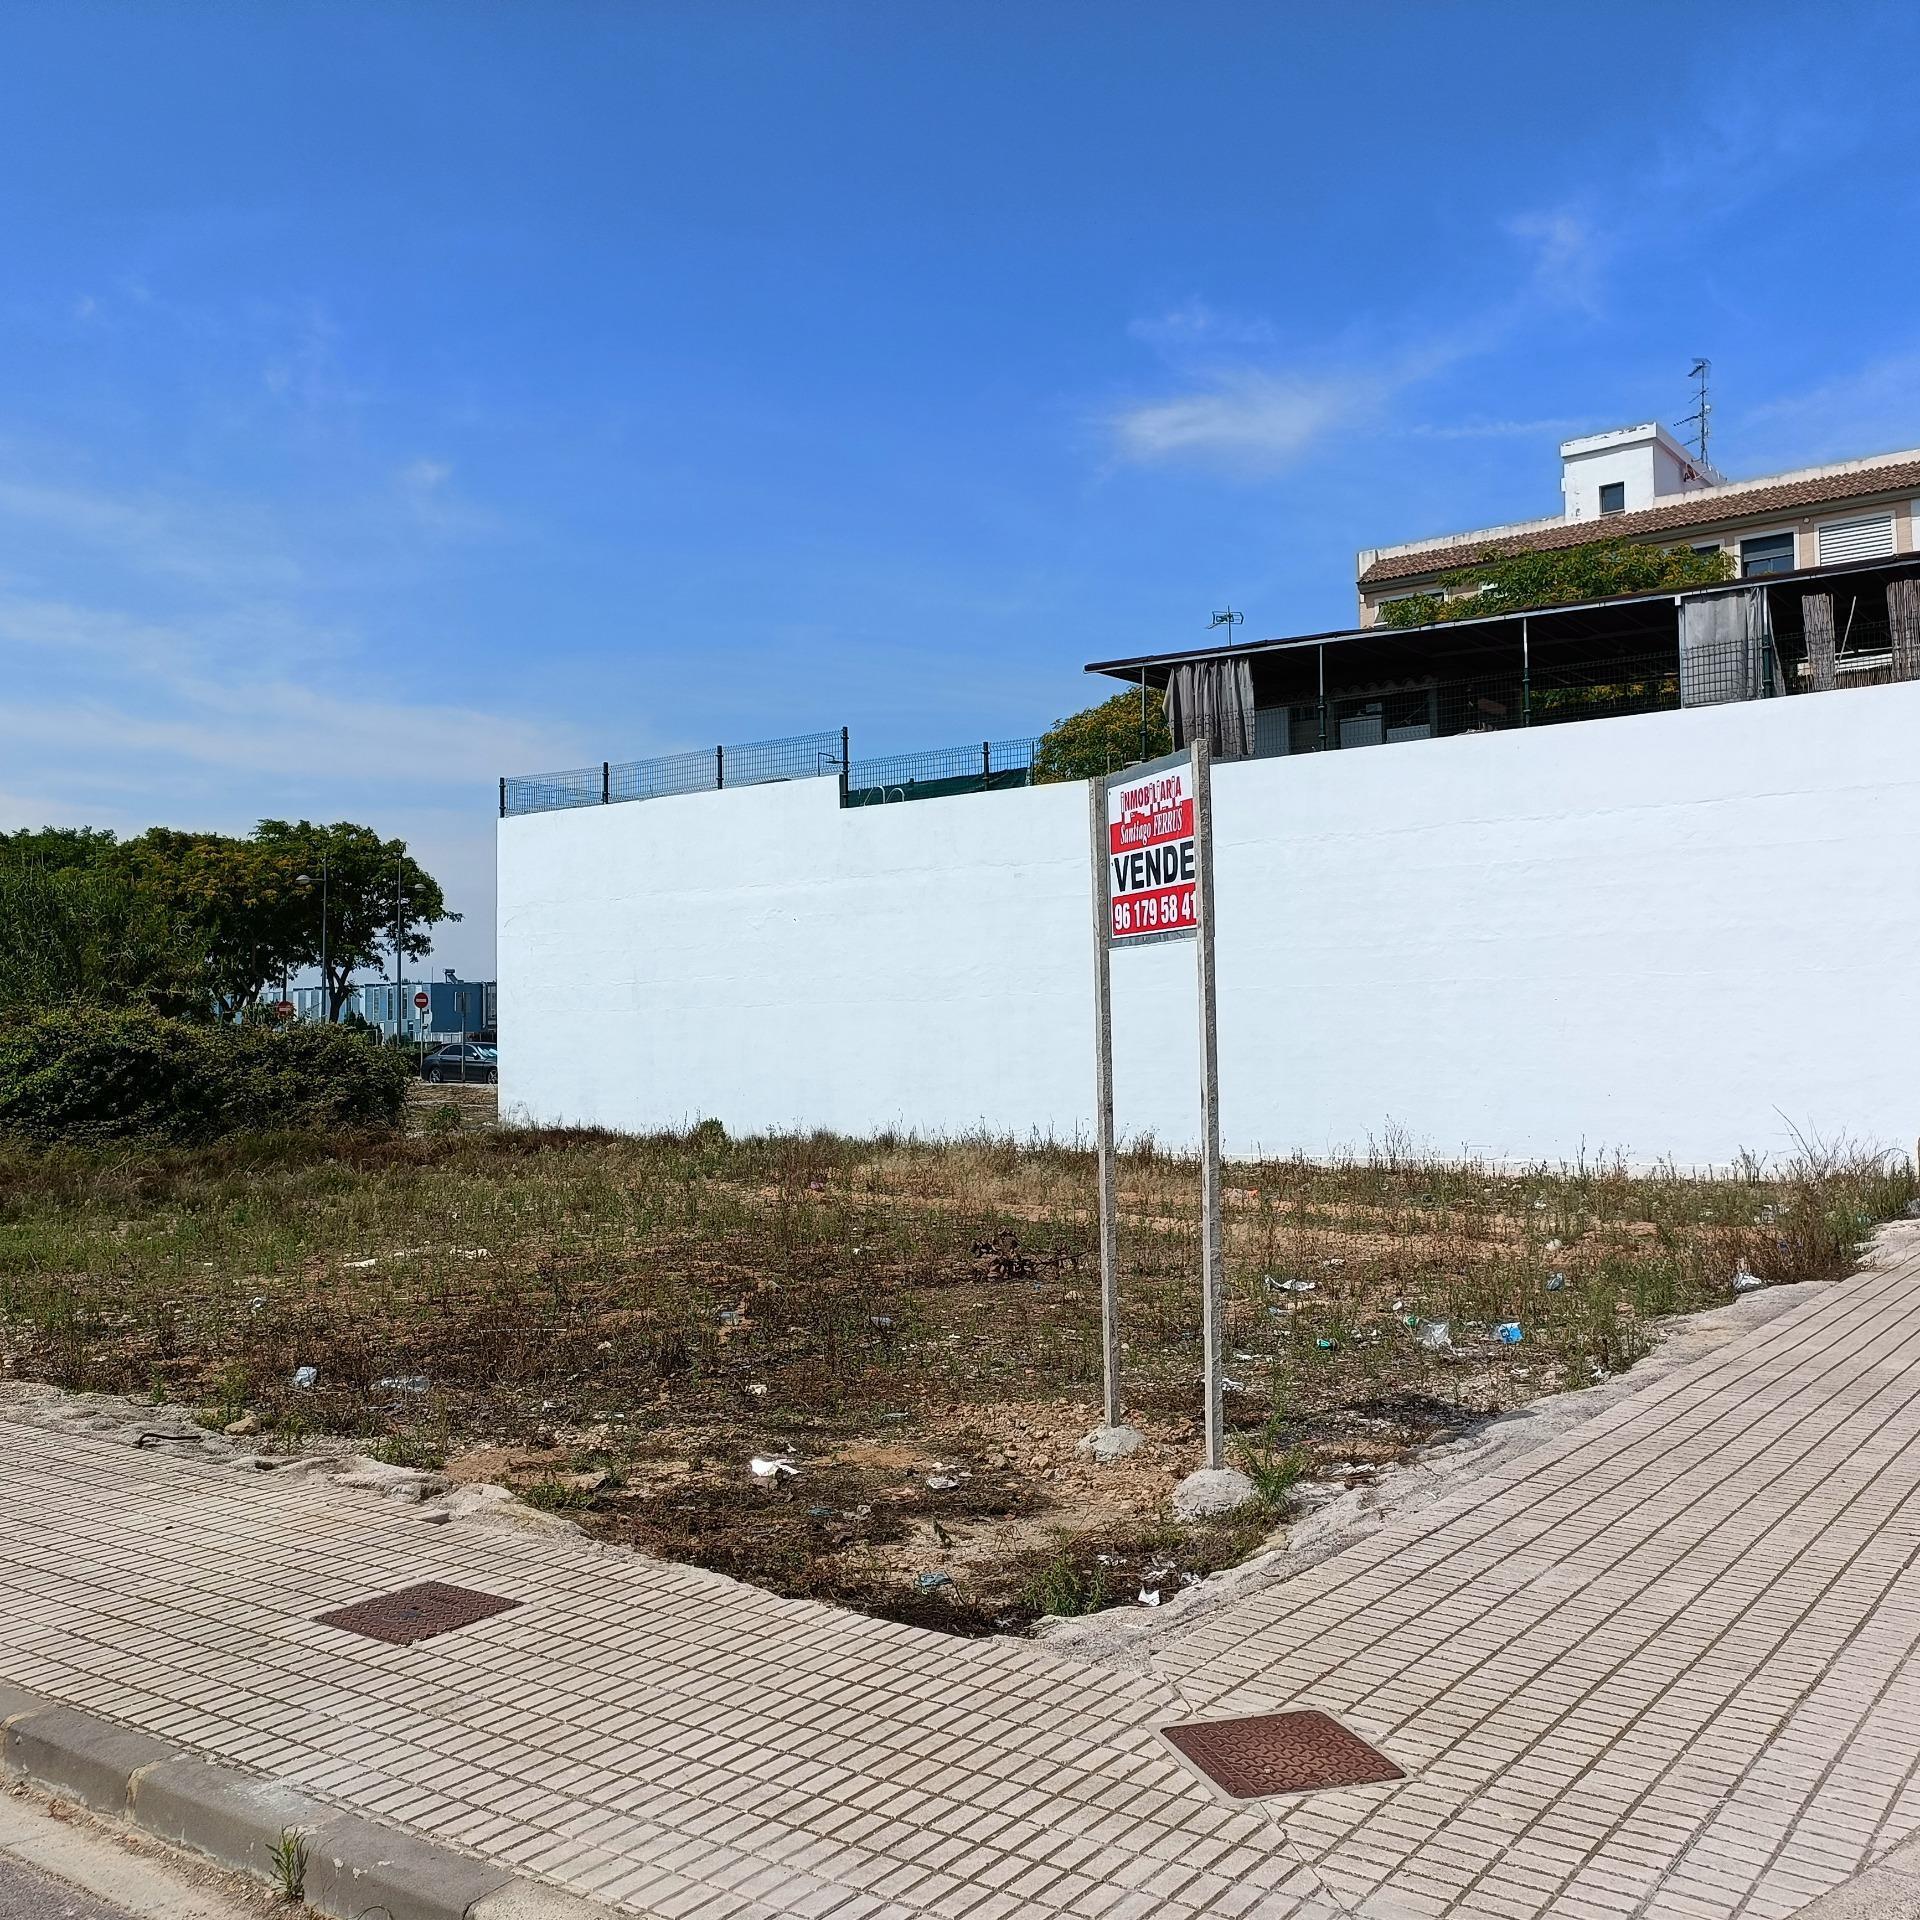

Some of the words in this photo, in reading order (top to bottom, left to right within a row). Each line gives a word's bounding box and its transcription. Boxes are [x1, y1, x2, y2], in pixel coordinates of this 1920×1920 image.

[1120, 820, 1152, 846] Santiago
[1114, 839, 1195, 893] VENDE
[1114, 902, 1131, 930] 96
[1134, 898, 1157, 928] 179
[1160, 894, 1178, 924] 58
[1181, 890, 1197, 920] 41
